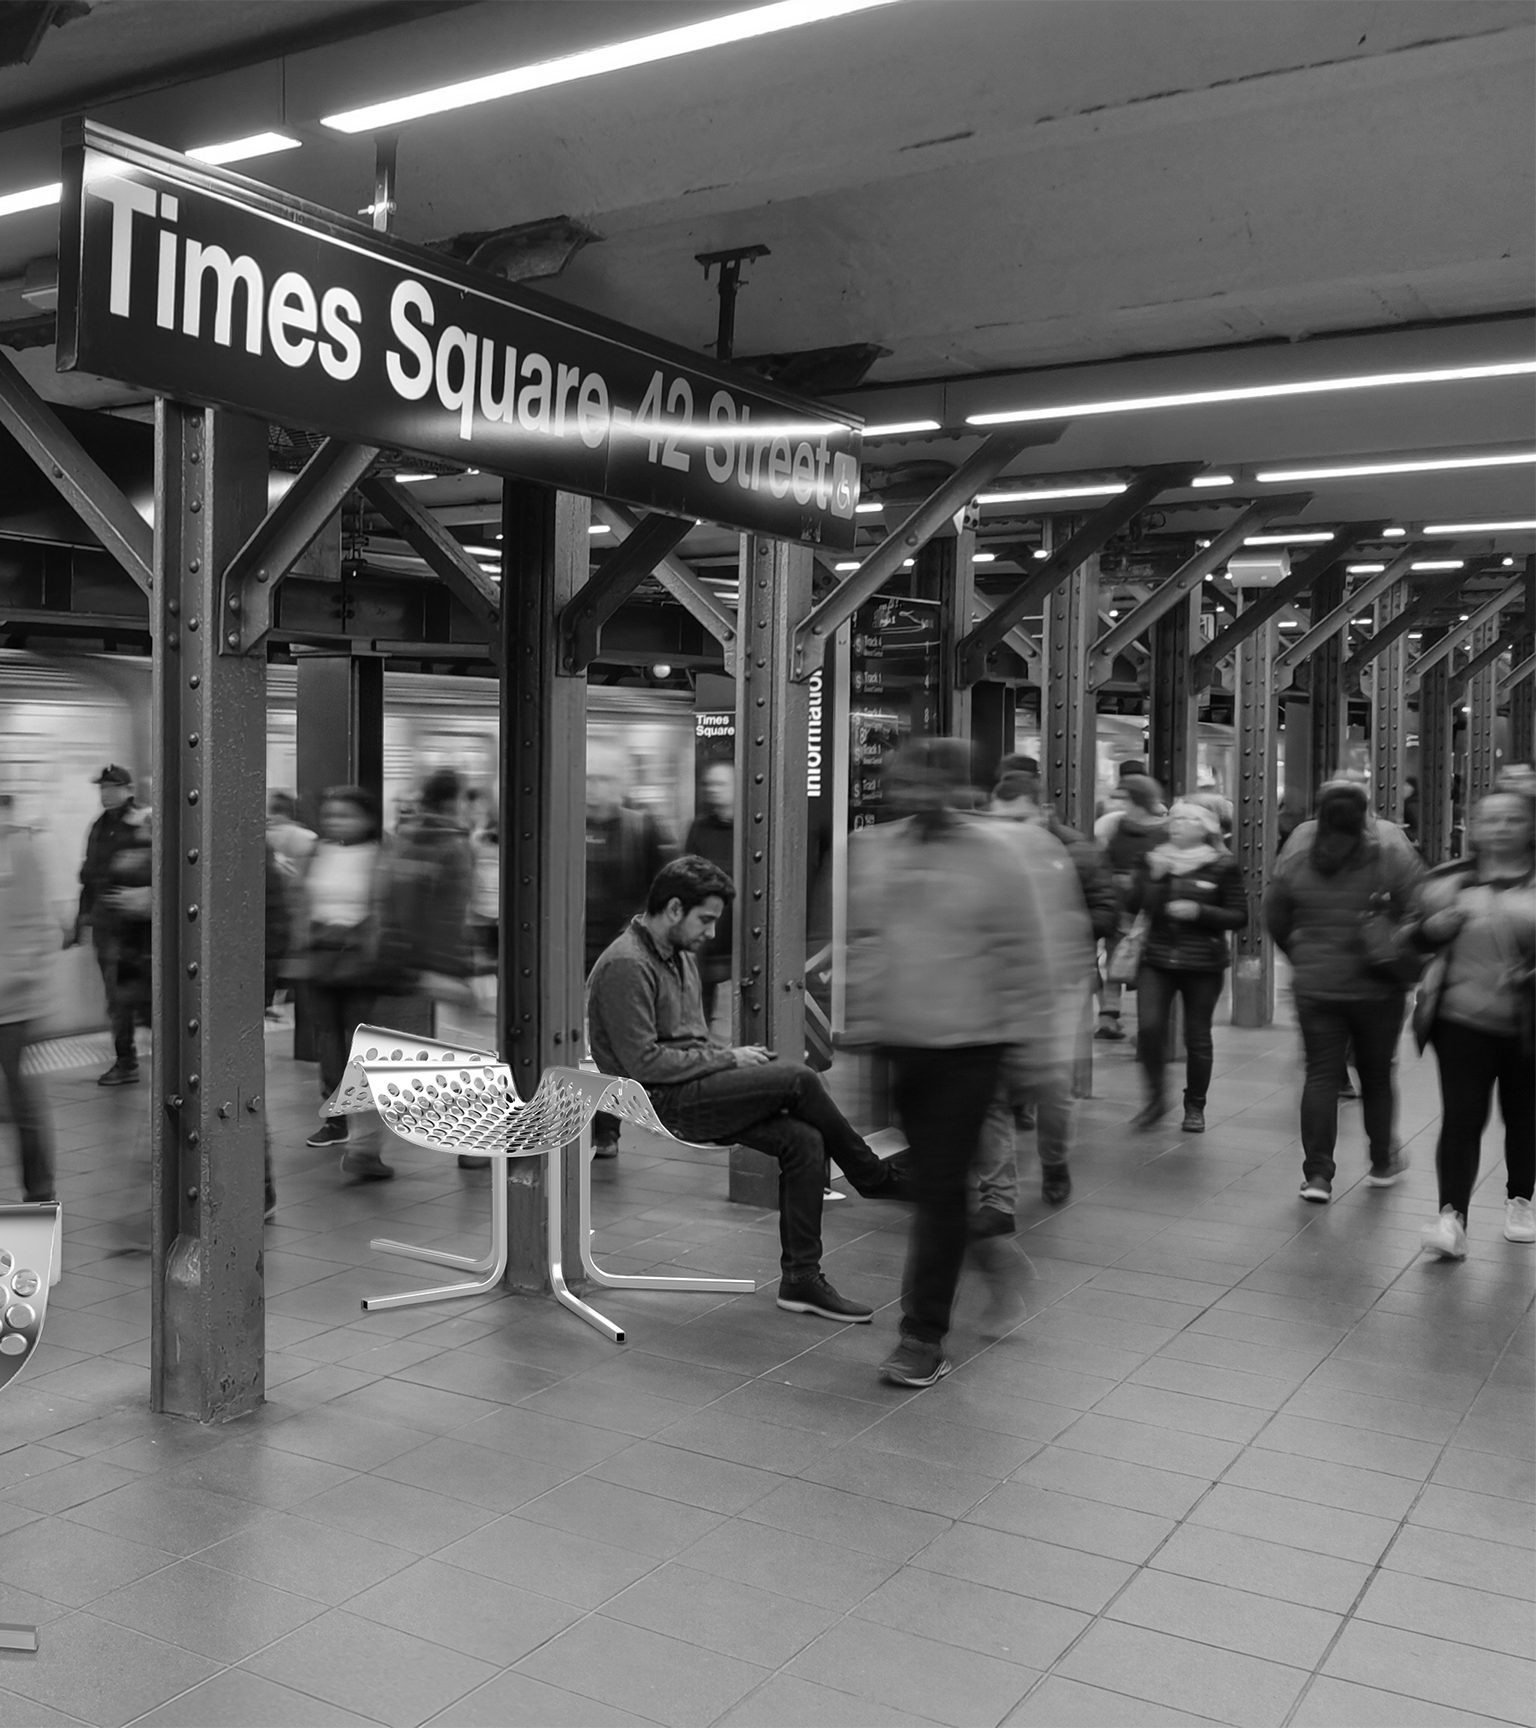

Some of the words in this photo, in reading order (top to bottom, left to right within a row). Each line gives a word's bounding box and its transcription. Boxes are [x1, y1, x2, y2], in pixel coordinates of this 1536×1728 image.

[86, 174, 363, 381] Times
[705, 390, 831, 510] Street
[696, 714, 729, 725] Times
[696, 725, 735, 738] Square
